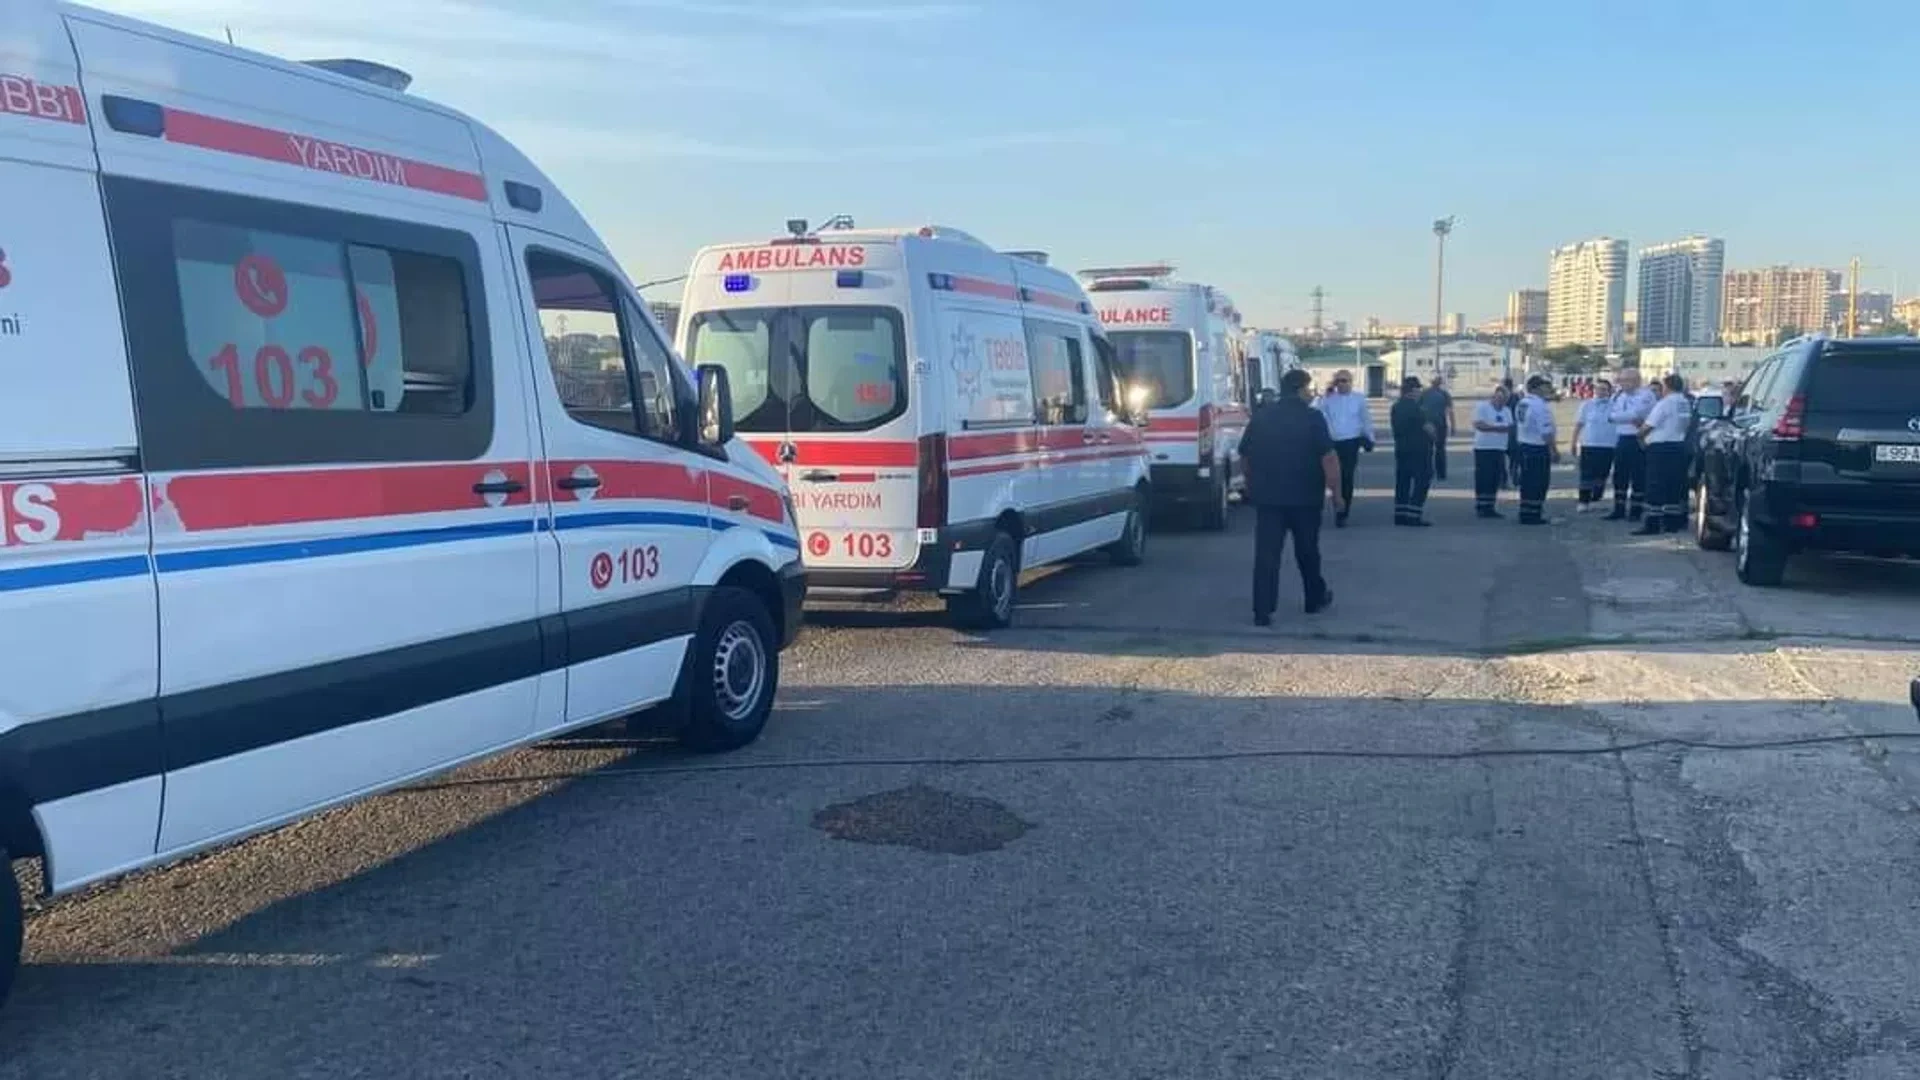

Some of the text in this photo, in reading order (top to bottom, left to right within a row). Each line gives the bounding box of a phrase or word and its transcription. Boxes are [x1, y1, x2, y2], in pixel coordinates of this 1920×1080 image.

[289, 135, 408, 186] YARDIM
[718, 247, 865, 271] AMBULANS
[210, 343, 338, 412] 103
[811, 493, 882, 510] YARDIM
[843, 533, 892, 557] 103
[618, 545, 659, 584] 103
